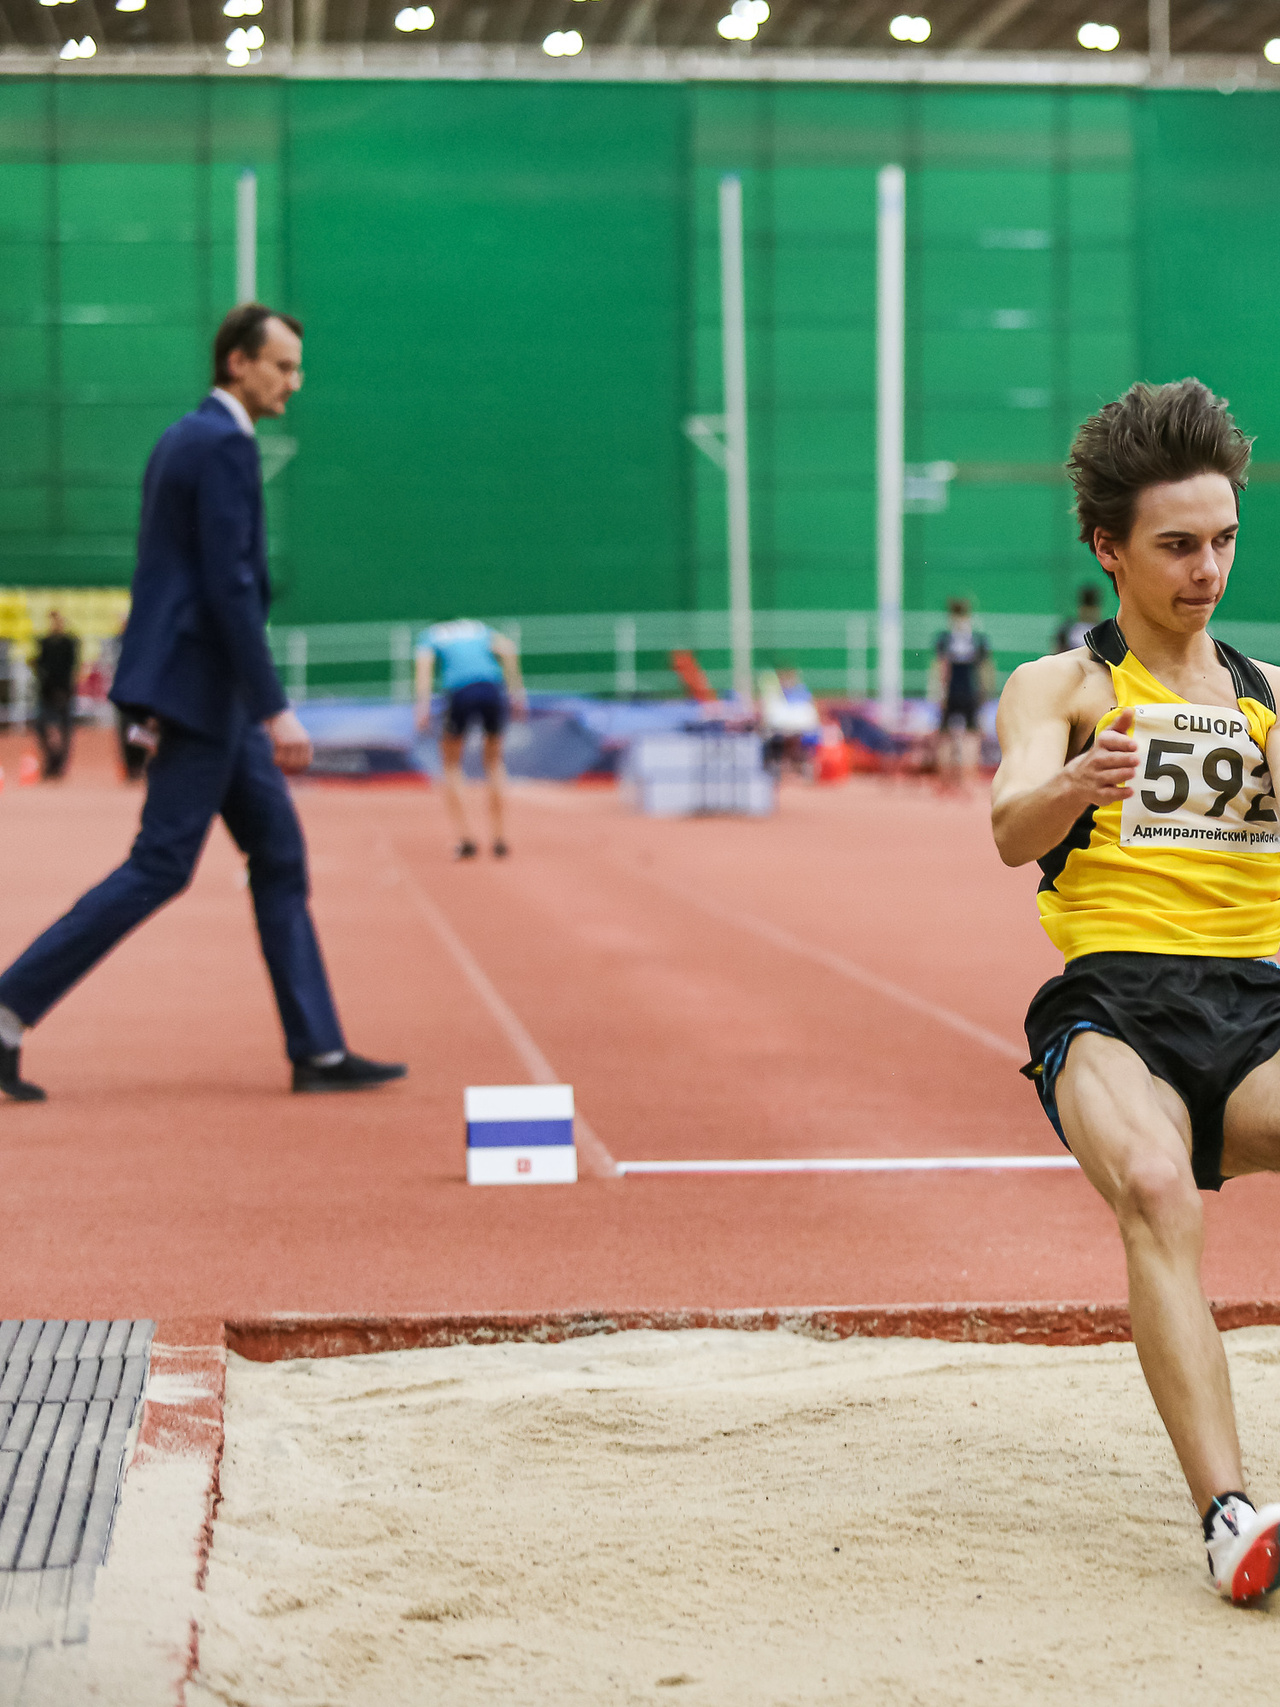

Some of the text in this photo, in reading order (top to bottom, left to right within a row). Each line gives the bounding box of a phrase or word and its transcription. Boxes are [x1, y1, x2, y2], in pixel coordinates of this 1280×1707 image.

[1173, 713, 1243, 738] СШОР
[1140, 738, 1278, 822] 592
[1132, 824, 1275, 845] Адмиралтейский район
